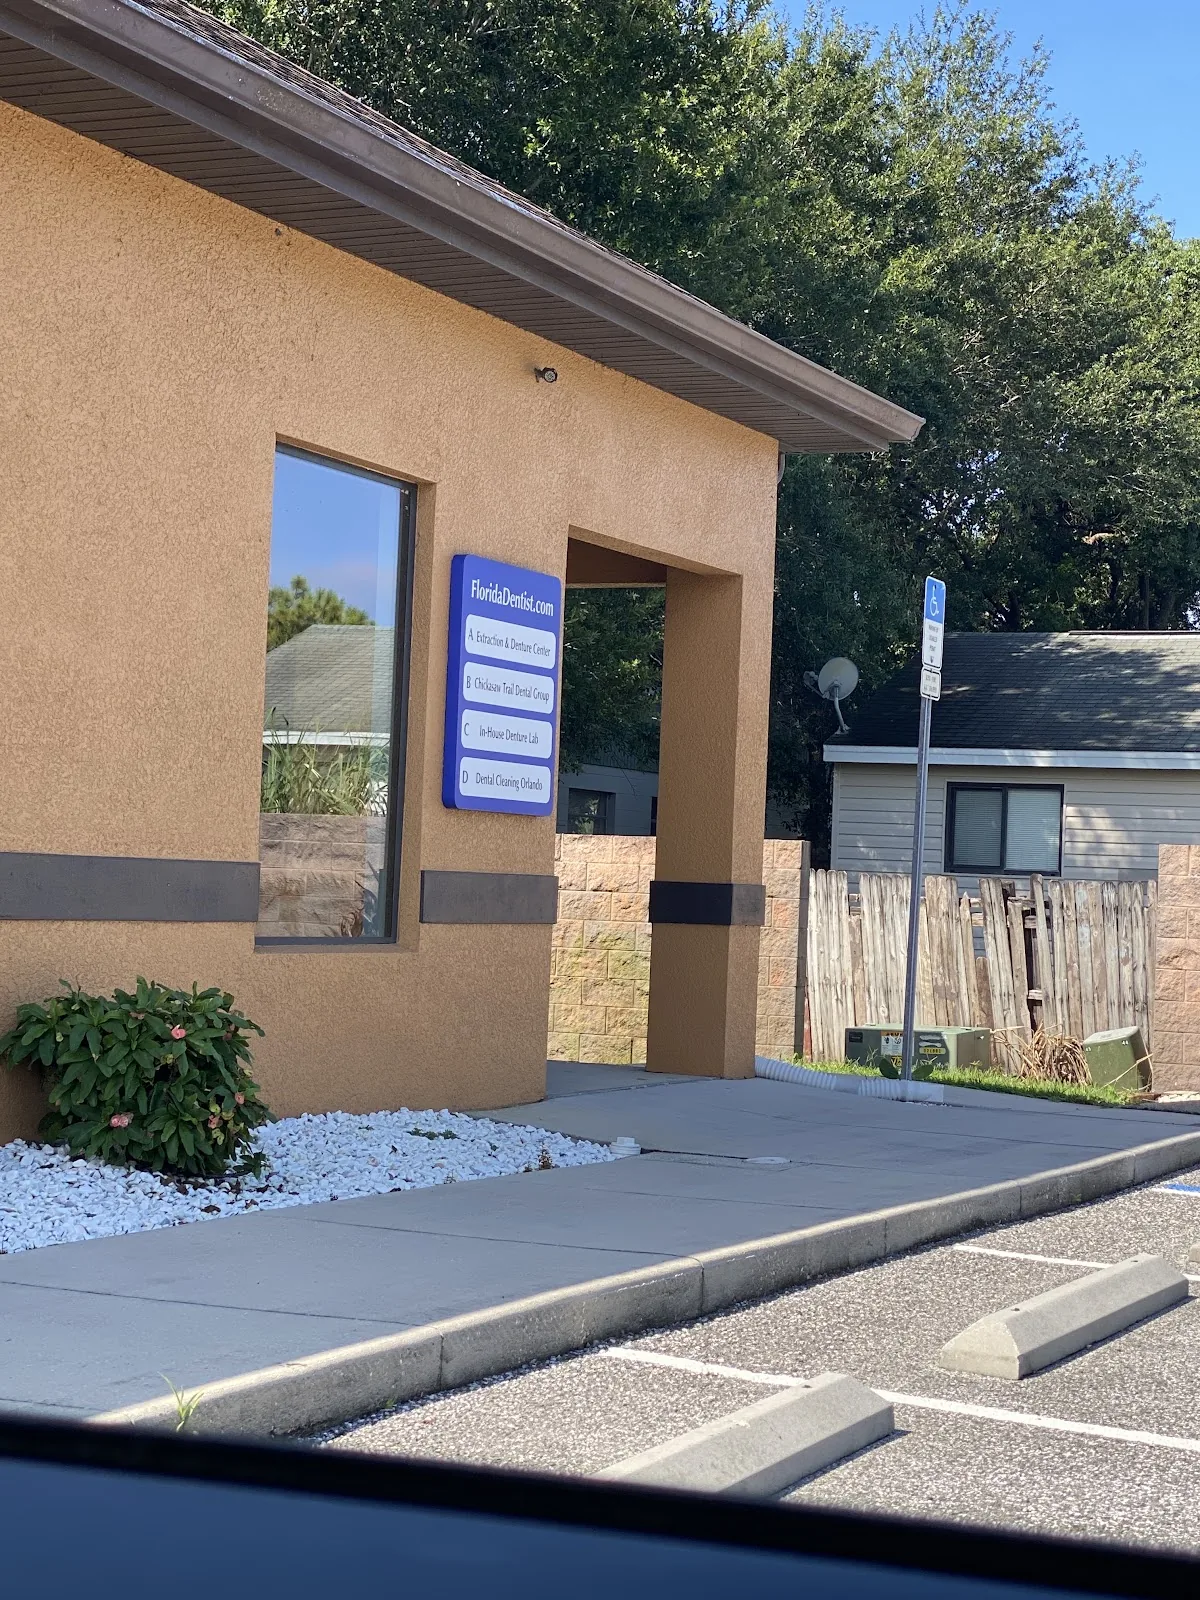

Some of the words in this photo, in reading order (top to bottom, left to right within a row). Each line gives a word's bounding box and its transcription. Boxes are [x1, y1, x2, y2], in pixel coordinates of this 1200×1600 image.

[471, 579, 554, 617] FloridaDentist.com
[468, 628, 473, 640] A
[476, 631, 504, 648] Extraction
[505, 637, 510, 649] &
[510, 638, 532, 654] Denture
[533, 643, 551, 657] Center
[466, 676, 471, 689] B
[474, 677, 501, 693] Chickasaw
[503, 682, 515, 695] Trail
[515, 684, 533, 698] Dental
[533, 687, 550, 704] Group
[464, 722, 470, 736] C
[479, 725, 504, 740] In-House
[505, 729, 528, 743] Denture
[528, 732, 539, 745] Lab
[462, 770, 469, 784] D
[475, 772, 495, 786] Dental
[495, 774, 520, 791] Cleaning
[520, 777, 543, 791] Orlando
